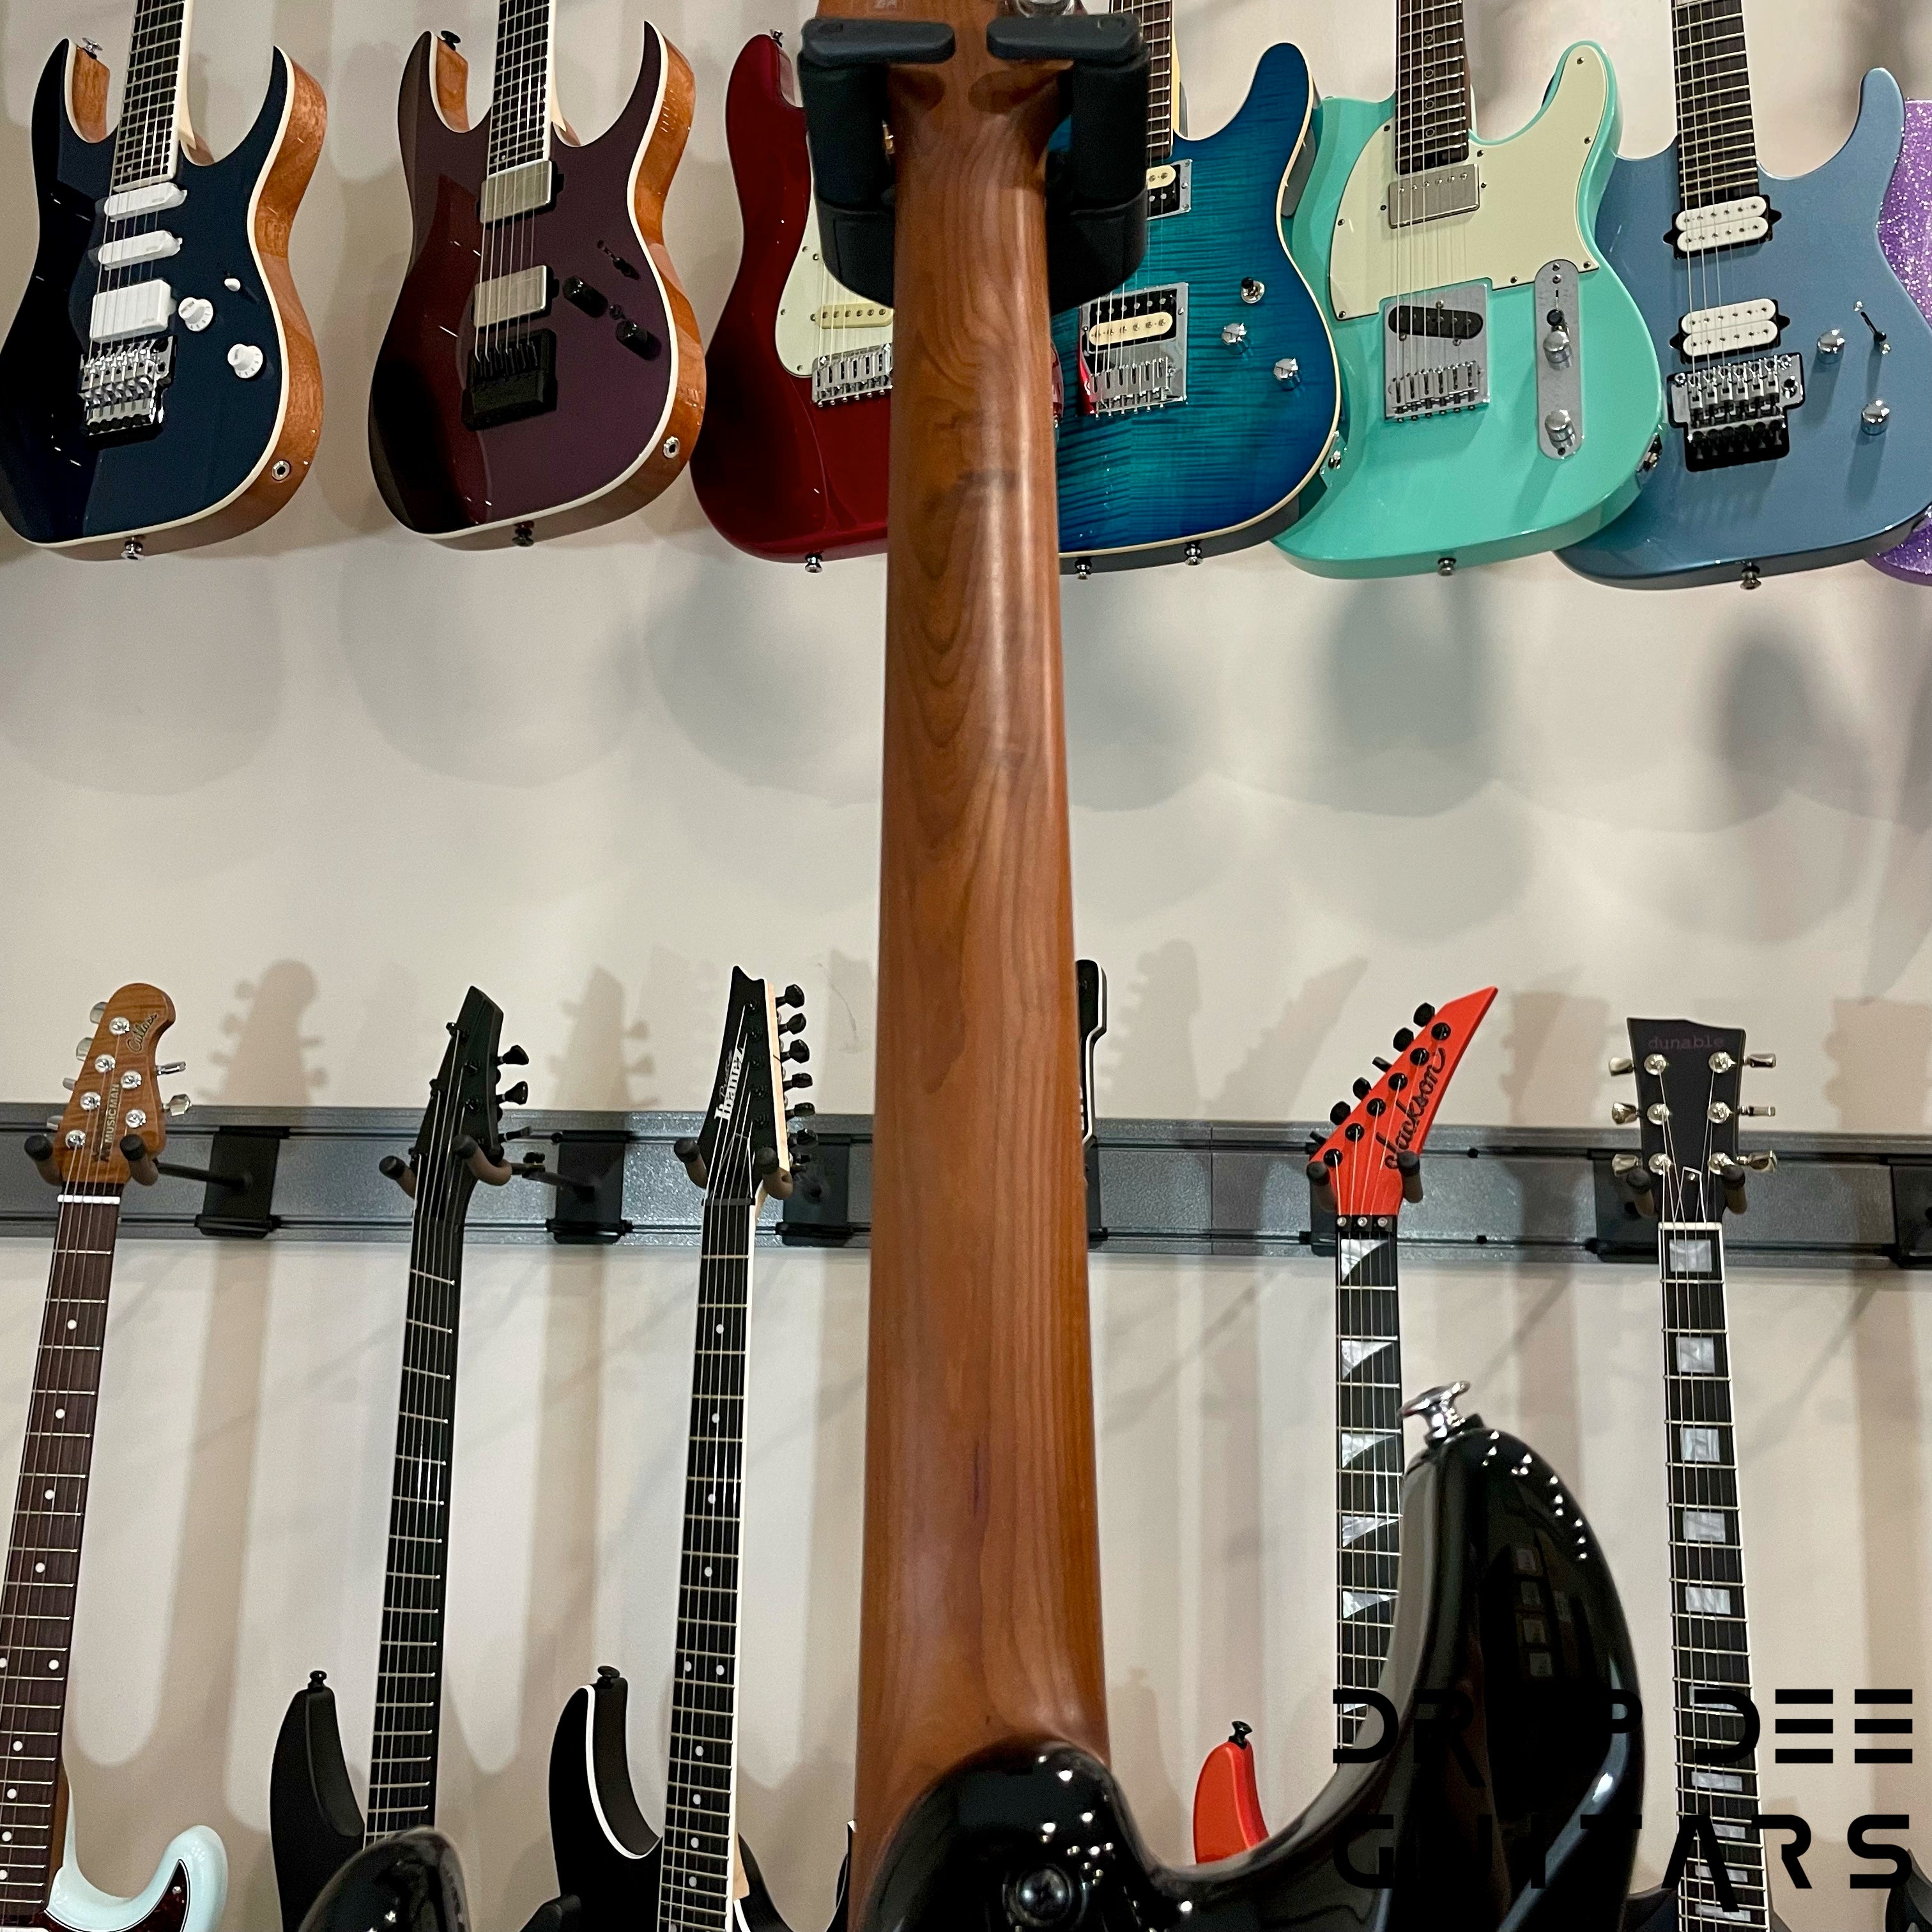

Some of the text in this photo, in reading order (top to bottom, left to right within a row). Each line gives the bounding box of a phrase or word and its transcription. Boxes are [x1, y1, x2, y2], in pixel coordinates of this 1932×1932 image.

[1648, 1035, 1724, 1049] dunable
[714, 1047, 744, 1120] Ibanez
[1376, 1048, 1446, 1169] Jackson
